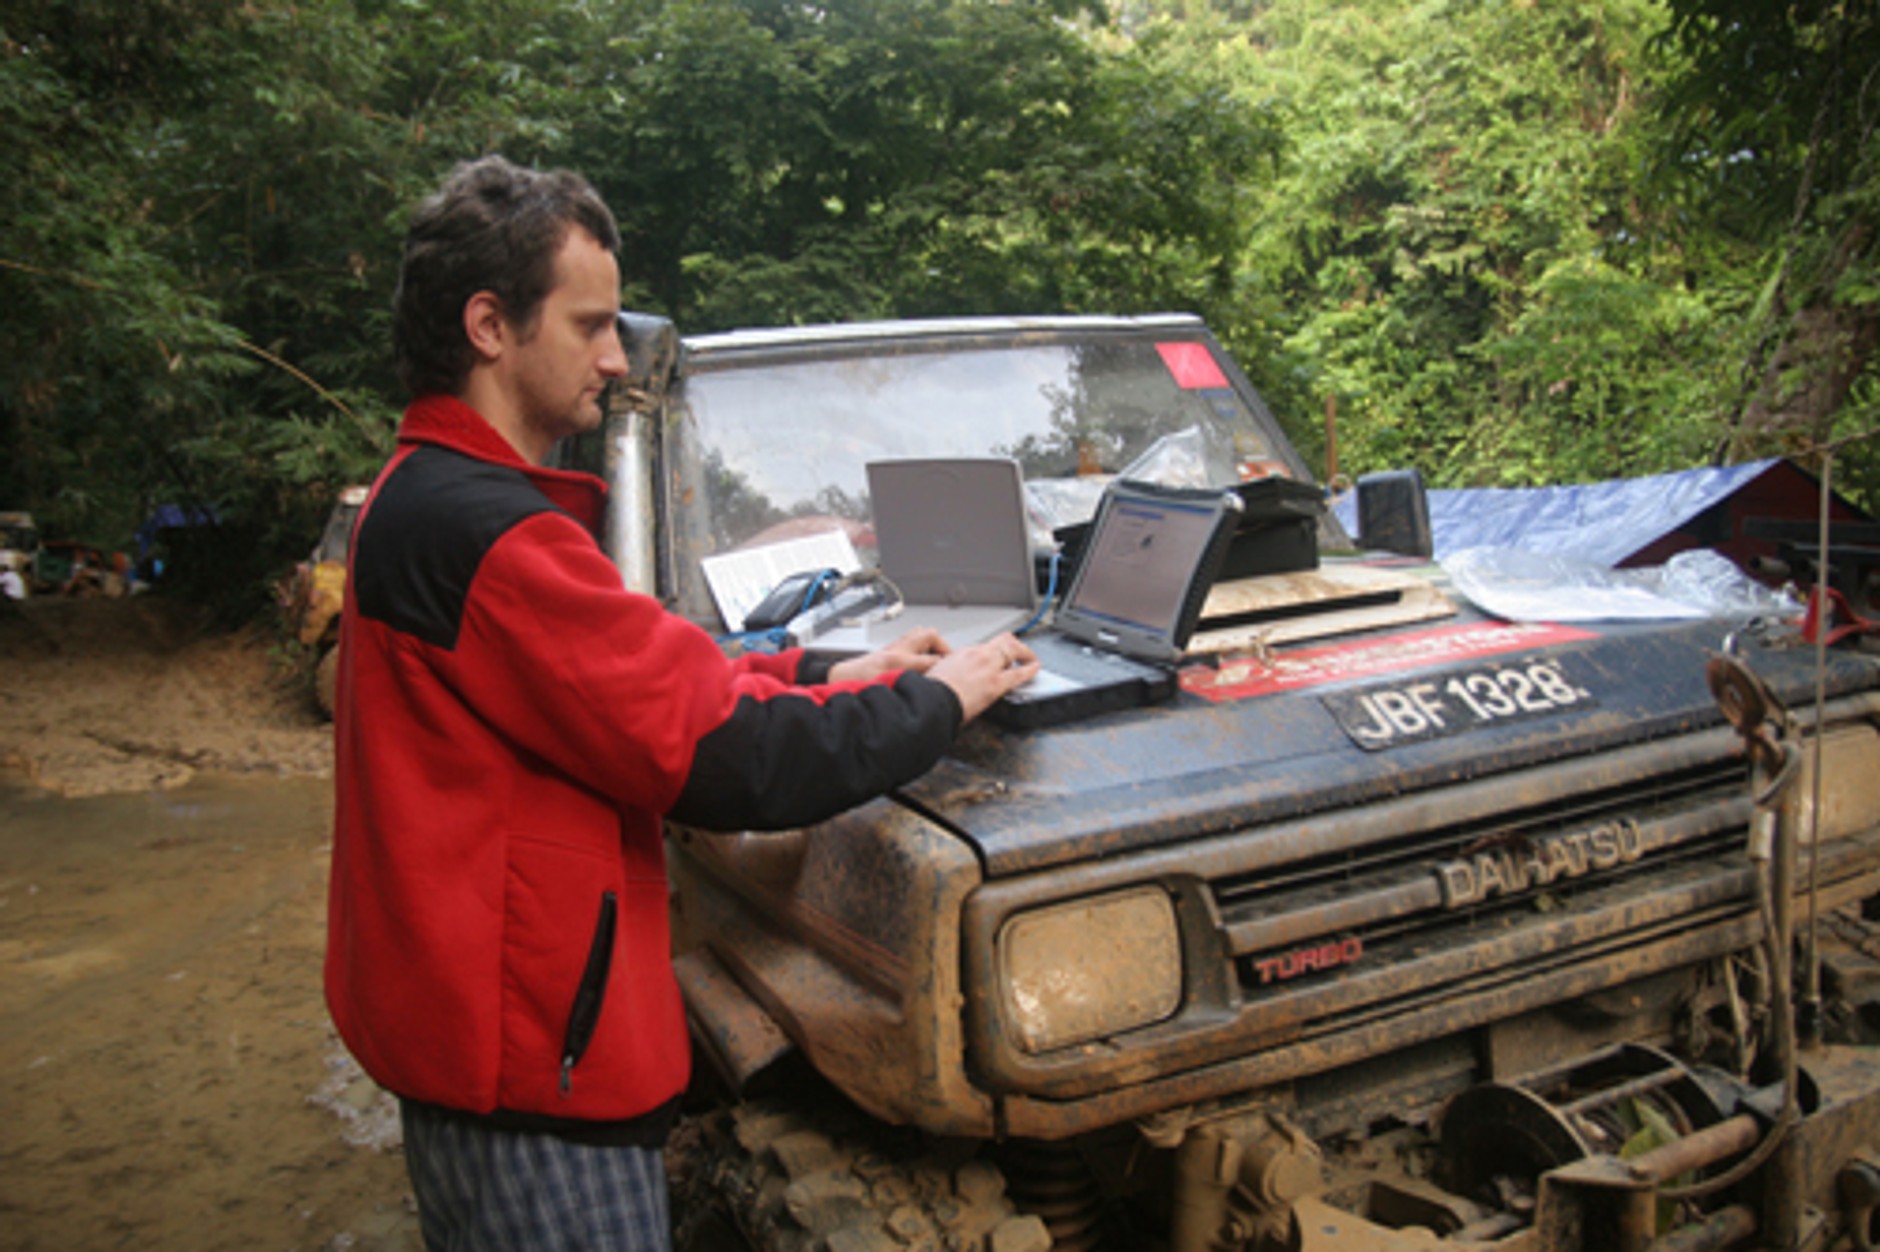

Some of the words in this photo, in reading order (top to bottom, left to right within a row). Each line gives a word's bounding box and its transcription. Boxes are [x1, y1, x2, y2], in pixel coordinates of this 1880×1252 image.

[1356, 683, 1446, 740] JBF
[1446, 663, 1579, 720] 1328
[1443, 817, 1642, 909] DAIHATSU
[1254, 937, 1363, 984] TURBO
